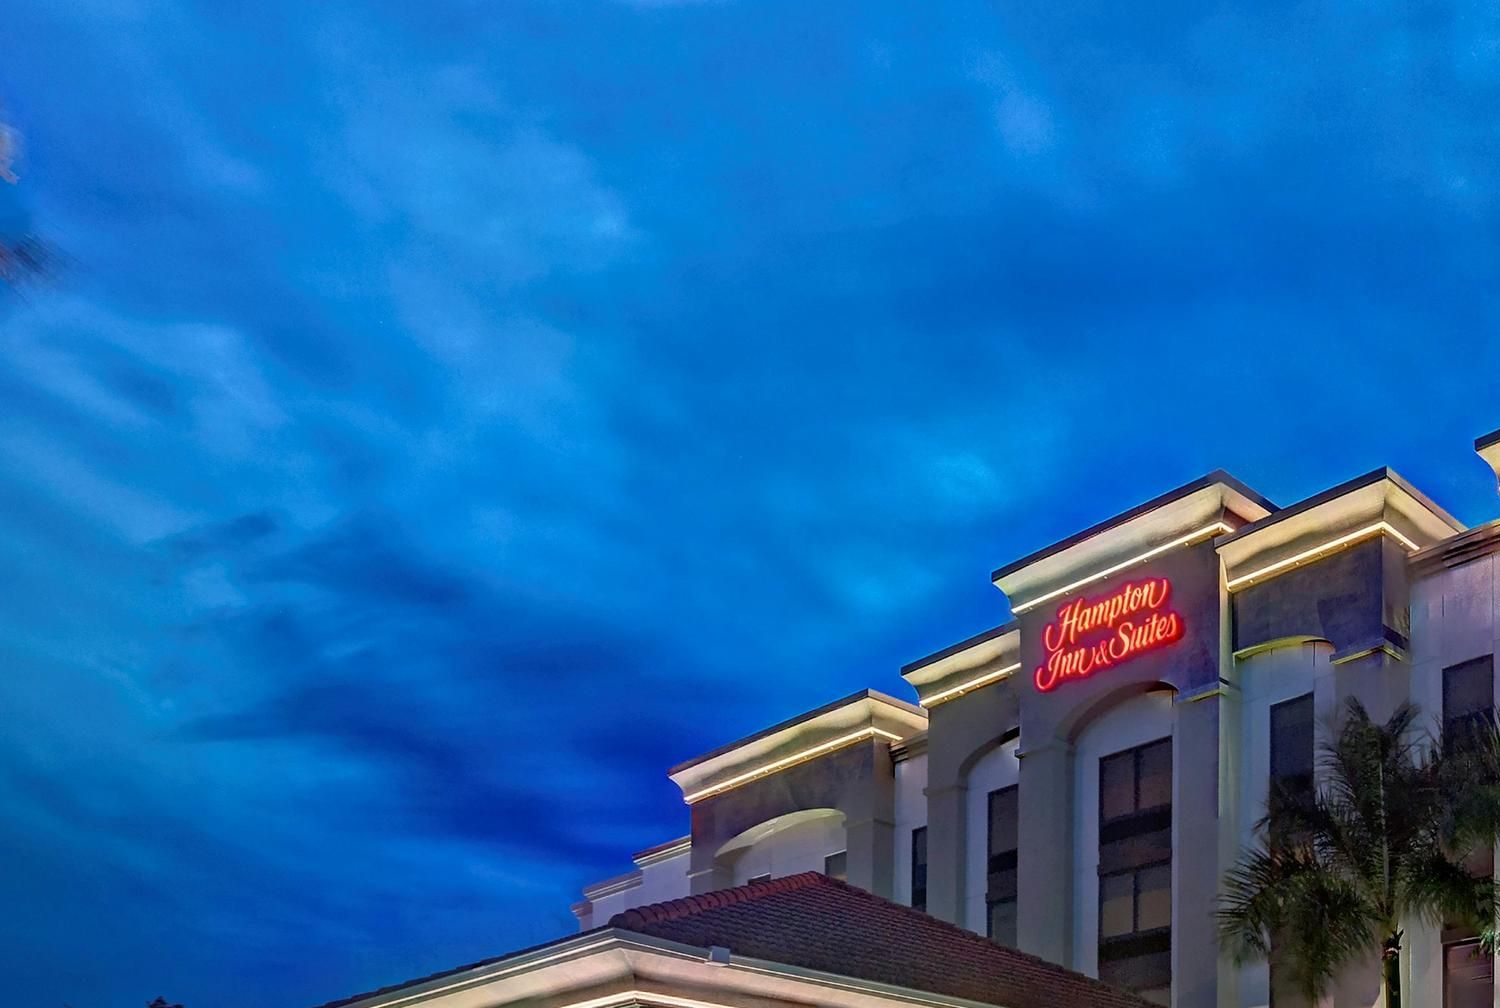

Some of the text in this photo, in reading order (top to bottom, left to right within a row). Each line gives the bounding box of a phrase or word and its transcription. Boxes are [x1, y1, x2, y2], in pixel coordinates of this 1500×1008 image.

[1036, 612, 1177, 690] Inn & Suites
[1045, 578, 1167, 652] Hampton
